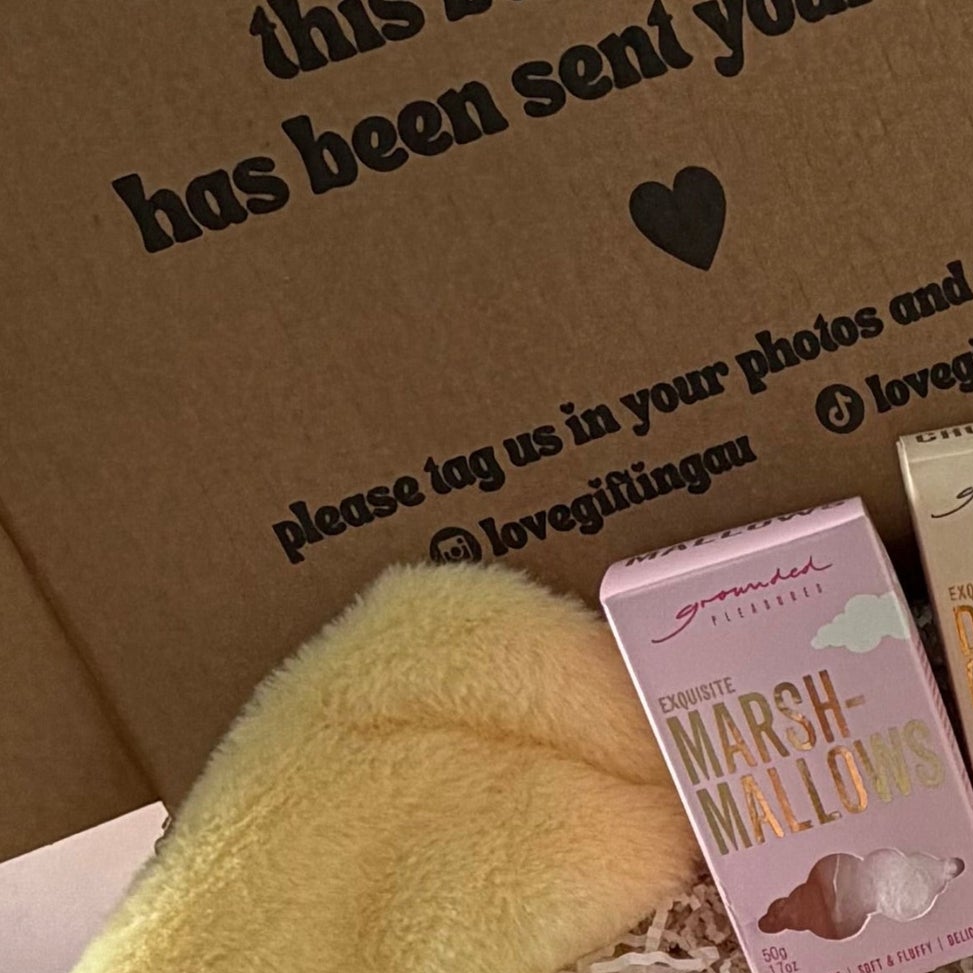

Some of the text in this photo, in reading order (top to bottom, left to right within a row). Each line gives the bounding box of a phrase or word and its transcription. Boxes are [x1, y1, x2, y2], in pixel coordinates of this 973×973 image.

[249, 0, 426, 79] this
[112, 173, 290, 254] has
[281, 80, 509, 195] been
[511, 0, 694, 118] sent
[272, 475, 426, 564] please
[424, 446, 506, 494] tag
[503, 425, 563, 467] us
[560, 402, 621, 446] in
[620, 360, 730, 437] your
[735, 306, 884, 395] photos
[478, 435, 758, 558] lovegiftingau
[651, 556, 833, 644] grounded
[658, 676, 736, 713] EXQUISITE
[665, 669, 865, 785] MARSH-
[695, 719, 945, 856] MALLOWS
[762, 946, 787, 962] 50g
[898, 943, 934, 965] FLUFFY
